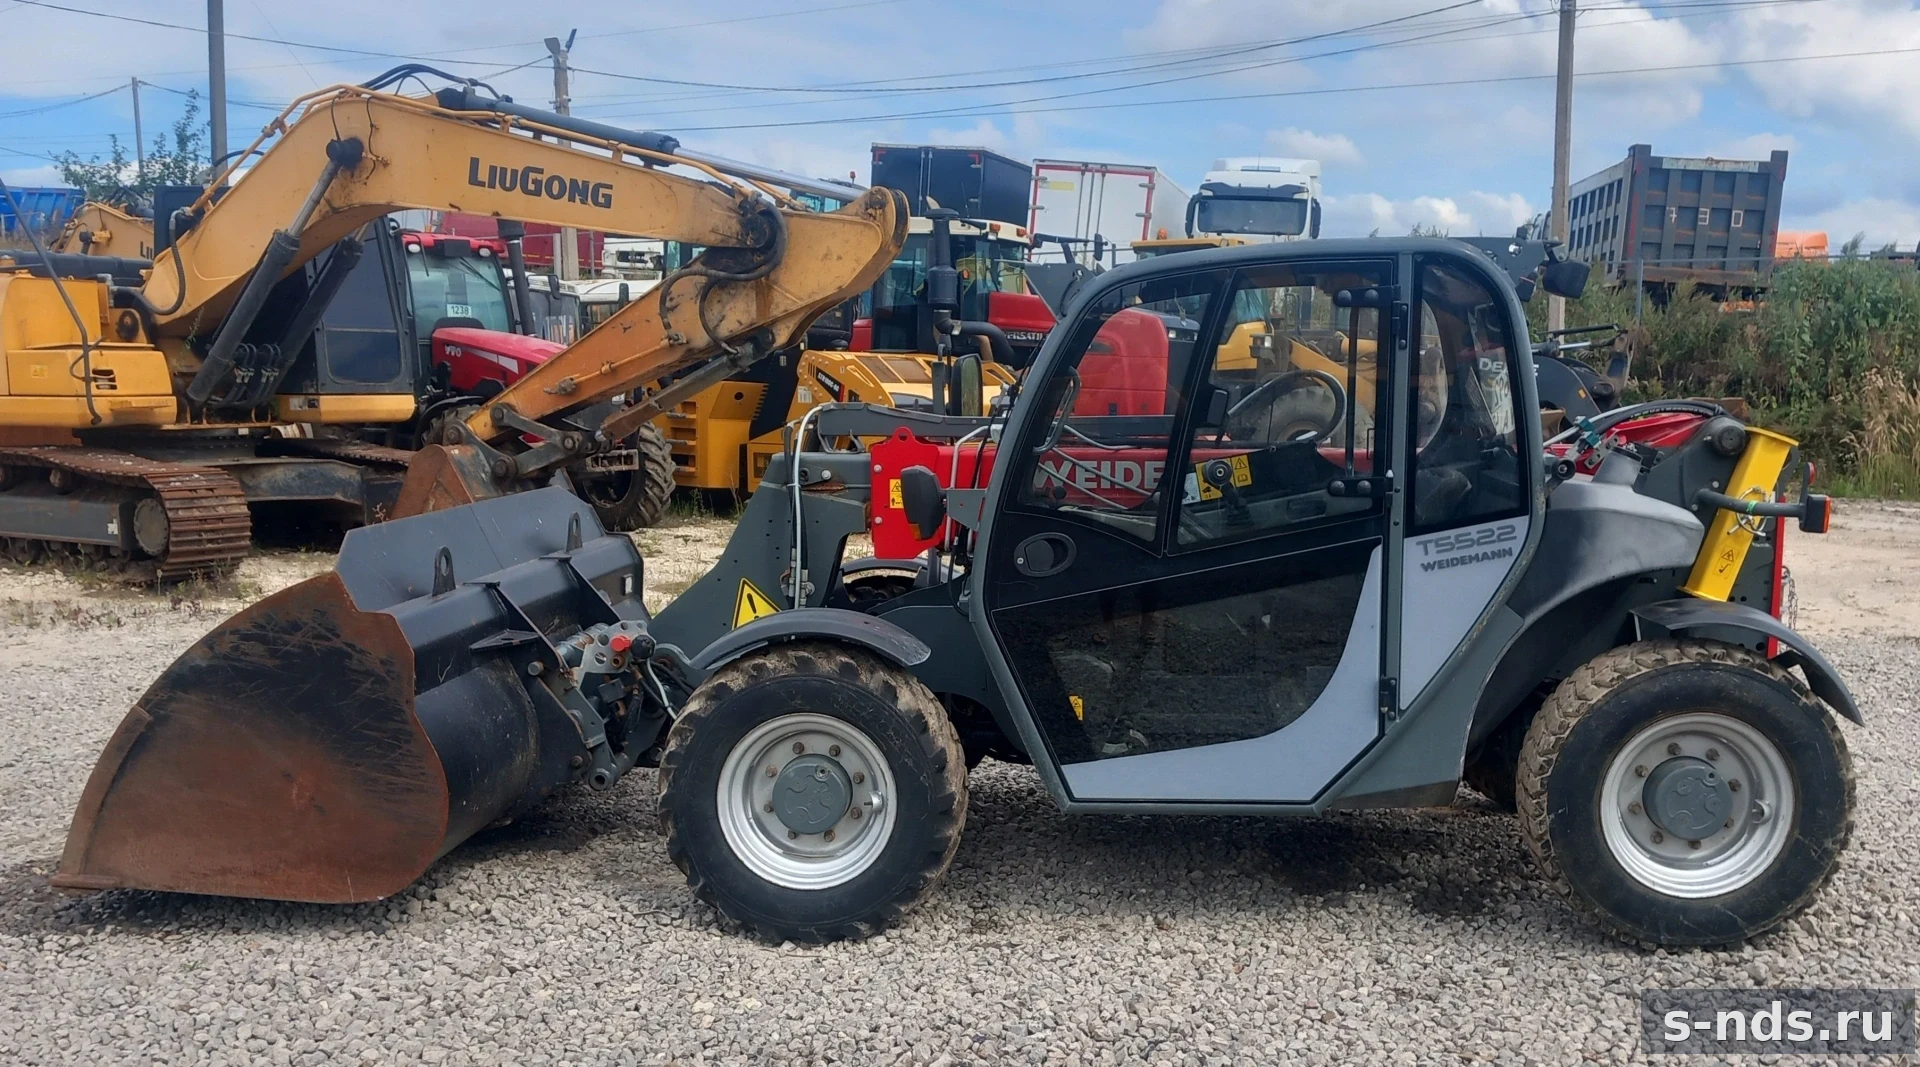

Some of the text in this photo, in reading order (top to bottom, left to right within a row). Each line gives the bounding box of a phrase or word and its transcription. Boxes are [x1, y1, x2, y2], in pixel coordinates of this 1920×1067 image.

[450, 305, 470, 315] 1238
[1416, 524, 1517, 556] T5522
[1420, 547, 1513, 572] WEIDEMANN
